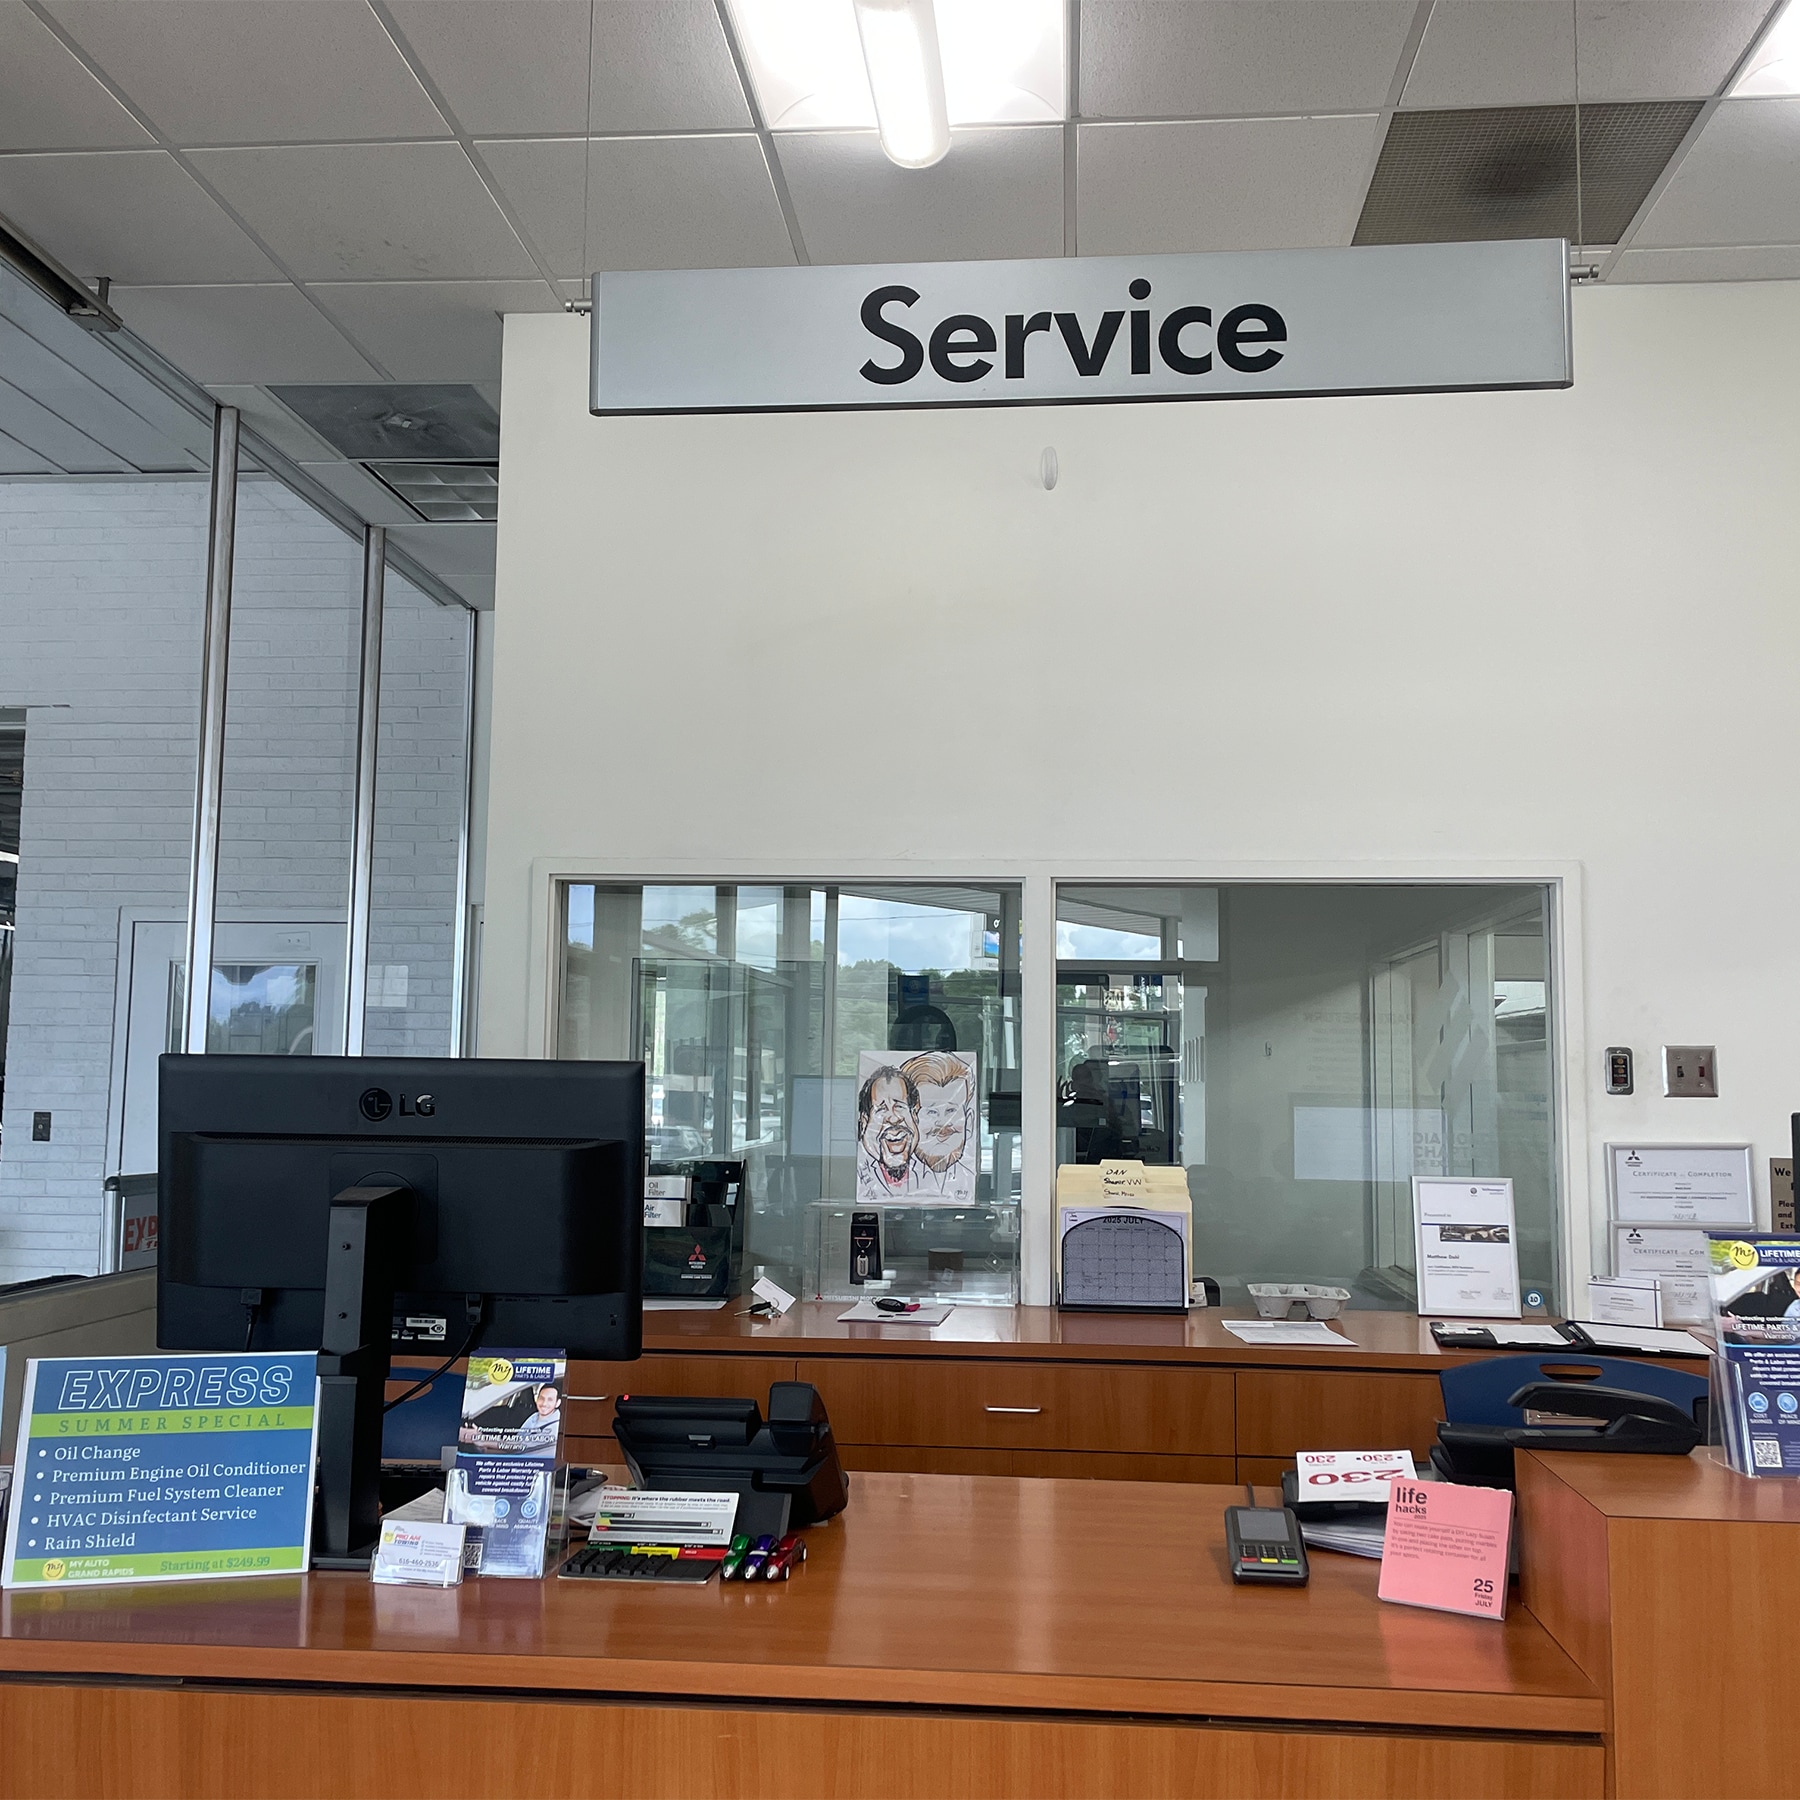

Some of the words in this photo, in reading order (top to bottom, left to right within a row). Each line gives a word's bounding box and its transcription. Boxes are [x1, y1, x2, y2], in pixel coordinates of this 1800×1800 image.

[860, 278, 1287, 386] Service
[399, 1094, 435, 1116] LG
[1774, 1167, 1791, 1177] We
[648, 1181, 659, 1189] Oil
[58, 1365, 293, 1410] EXPRESS
[59, 1417, 167, 1433] SUMMER
[182, 1413, 286, 1429] SPECIAL
[54, 1446, 78, 1460] Oil
[81, 1446, 141, 1461] Change
[52, 1468, 126, 1483] Premium
[129, 1466, 183, 1482] Engine
[187, 1463, 210, 1478] Oil
[213, 1461, 307, 1477] Conditioner
[49, 1490, 123, 1505] Premium
[127, 1487, 161, 1502] Fuel
[164, 1486, 220, 1504] System
[223, 1484, 285, 1499] Cleaner
[1396, 1486, 1428, 1504] life
[47, 1512, 97, 1528] HVAC
[100, 1509, 197, 1526] Disinfectant
[200, 1506, 258, 1521] Service
[1395, 1503, 1427, 1514] hacks
[44, 1535, 81, 1550] Rain
[85, 1533, 136, 1548] Shield
[69, 1560, 82, 1568] MY
[84, 1558, 110, 1568] AUTO
[160, 1558, 210, 1573] Starting
[212, 1559, 223, 1569] at
[226, 1555, 271, 1569] $249.99
[68, 1568, 100, 1579] GRAND
[101, 1567, 134, 1577] RAPIDS
[1473, 1578, 1493, 1593] 25
[1475, 1592, 1493, 1601] Friday
